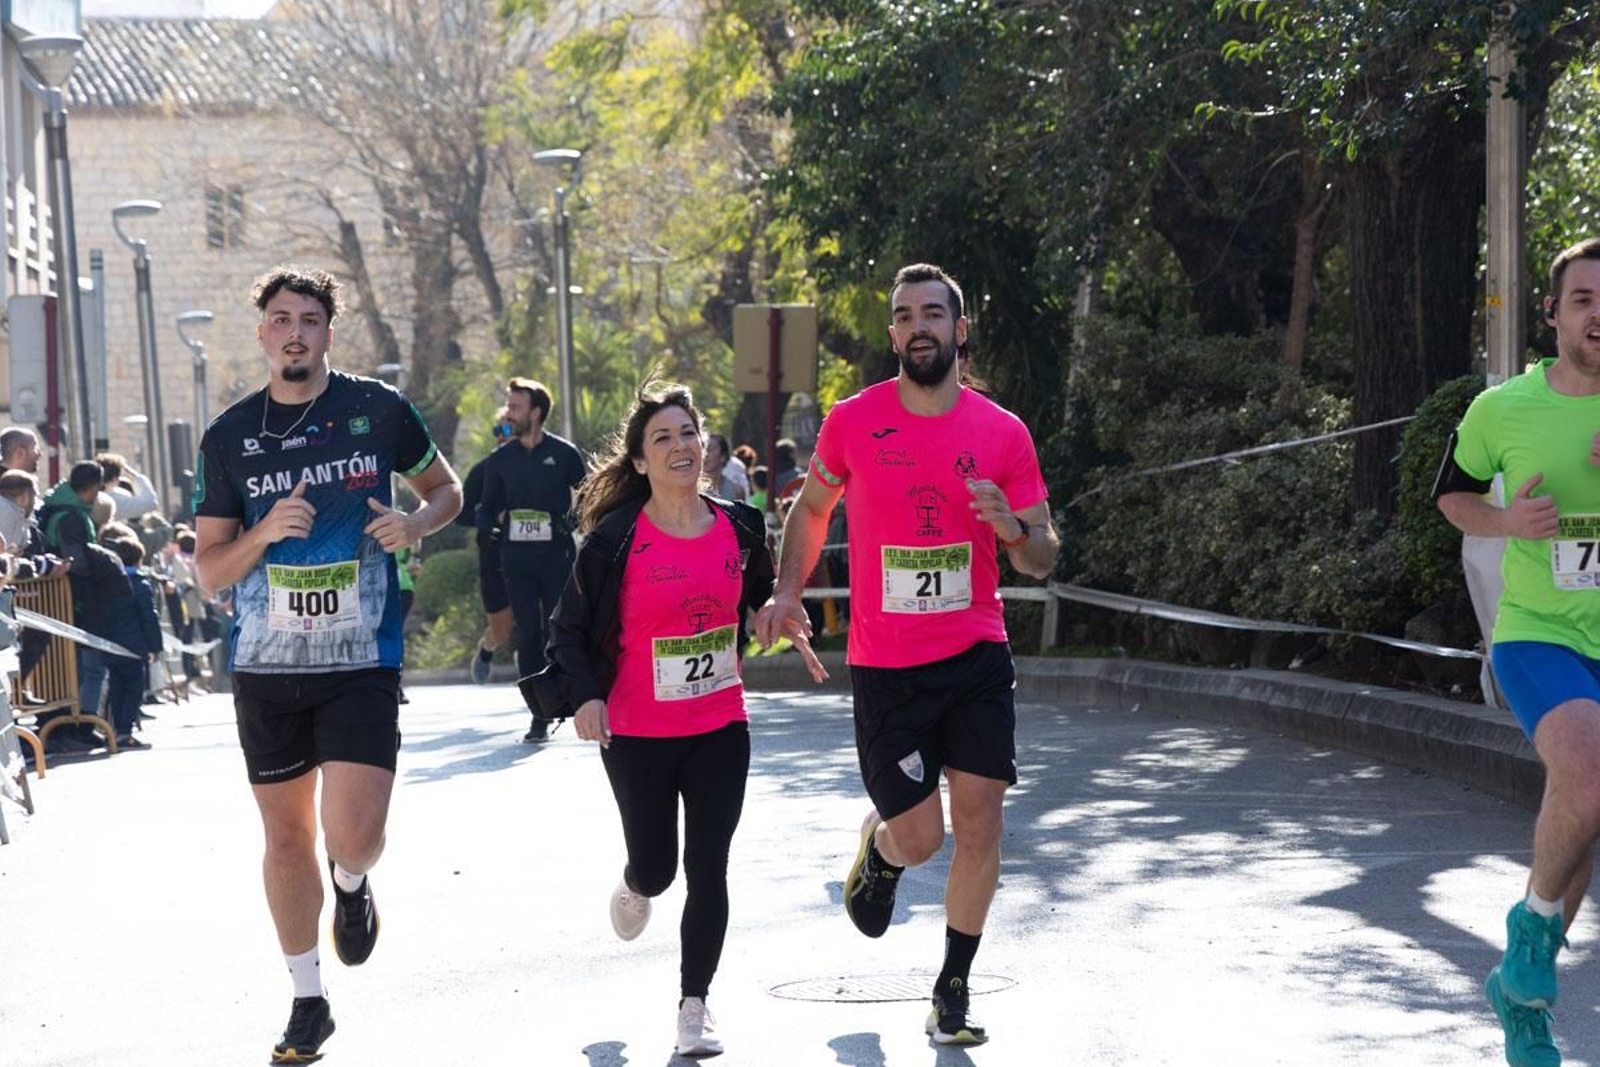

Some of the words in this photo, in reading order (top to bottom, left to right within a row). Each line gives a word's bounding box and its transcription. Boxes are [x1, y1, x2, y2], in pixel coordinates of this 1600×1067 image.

[281, 435, 307, 450] jaén
[246, 470, 293, 498] SAN
[301, 451, 378, 485] ANTÓN
[519, 521, 541, 534] 704
[1576, 541, 1600, 571] 7
[916, 571, 942, 598] 21
[288, 589, 339, 617] 400
[684, 653, 715, 683] 22
